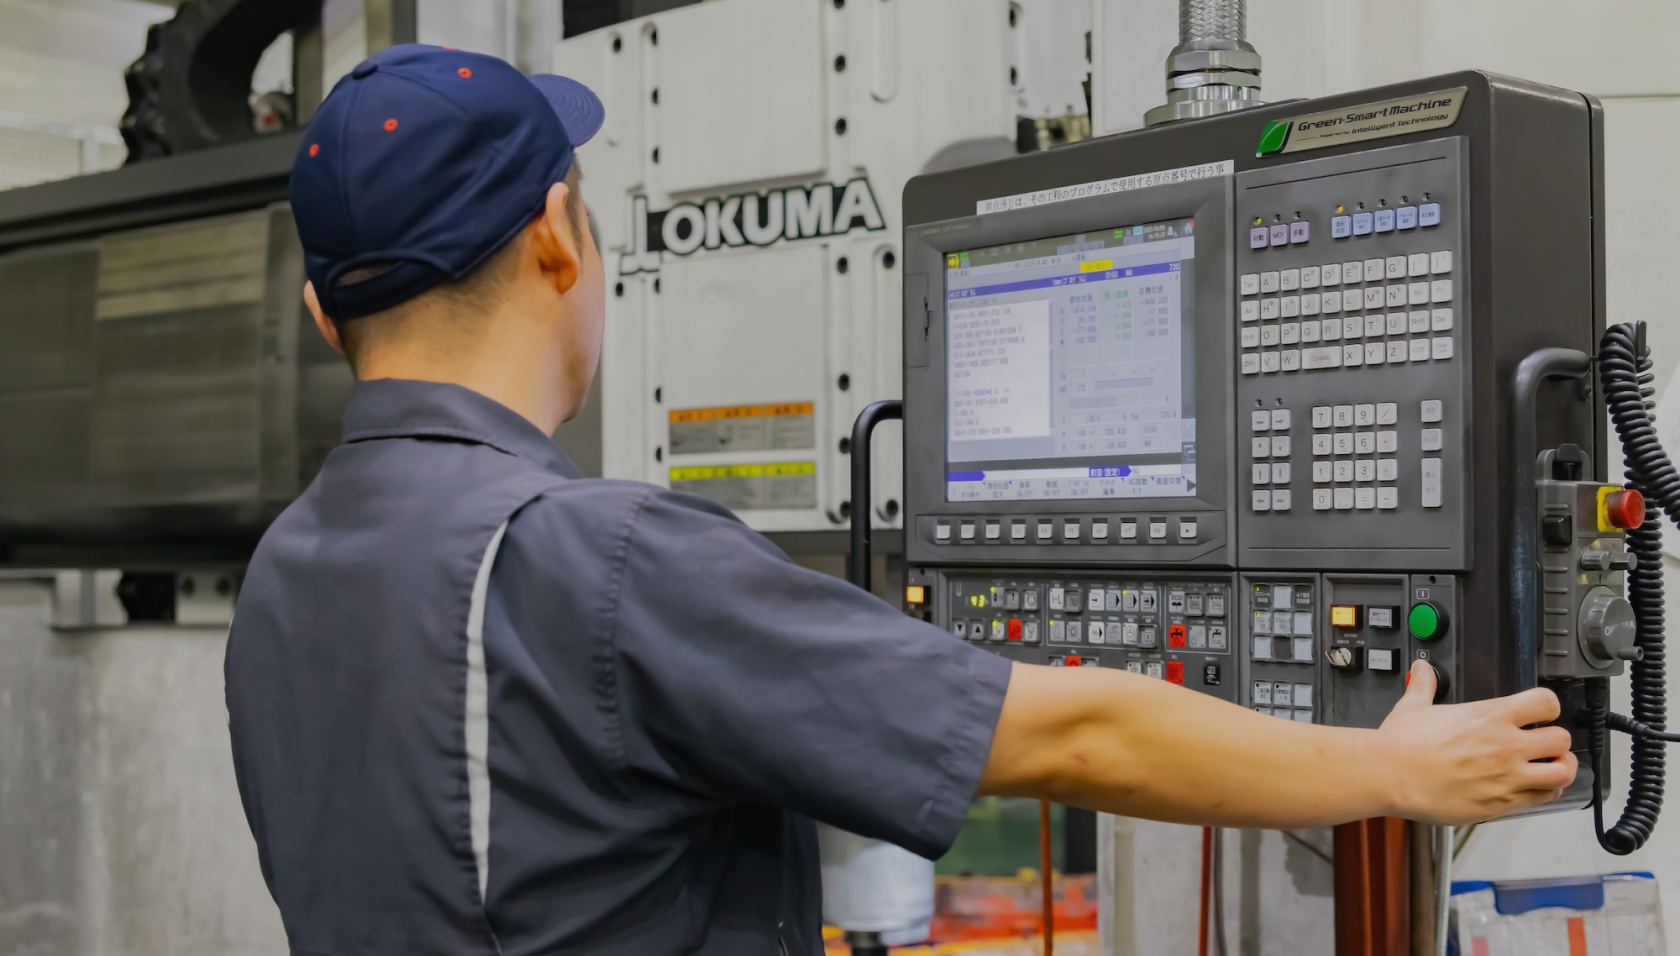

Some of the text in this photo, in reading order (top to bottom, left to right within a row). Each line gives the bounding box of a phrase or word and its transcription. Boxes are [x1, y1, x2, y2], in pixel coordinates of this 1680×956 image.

[1389, 98, 1452, 116] Machine
[1351, 121, 1396, 134] Intelligent
[1397, 113, 1449, 128] Technology
[660, 177, 886, 256] OKUMA
[1293, 229, 1304, 237] 手動
[1367, 265, 1373, 274] F
[1388, 264, 1396, 272] G
[1303, 273, 1310, 282] C
[1324, 271, 1331, 280] D
[1346, 269, 1352, 277] E
[1283, 276, 1290, 284] B
[1346, 296, 1352, 304] L
[1366, 294, 1374, 302] M
[1389, 291, 1396, 300] N
[1304, 300, 1310, 309] J
[1324, 298, 1331, 306] K
[1263, 305, 1269, 313] H
[1346, 323, 1353, 332] S
[1368, 321, 1374, 331] T
[1390, 319, 1397, 329] U
[1145, 328, 1168, 337] 100000
[1284, 329, 1290, 338] P
[1304, 327, 1311, 337] Q
[1324, 325, 1331, 334] R
[1346, 351, 1353, 360] X
[1367, 349, 1375, 358] Y
[1390, 347, 1397, 357] Z
[1263, 357, 1270, 366] V
[1282, 356, 1292, 364] W
[1318, 412, 1324, 422] 7
[1339, 411, 1345, 421] 8
[1360, 410, 1367, 420] 9
[1318, 440, 1324, 448] 4
[1339, 438, 1345, 448] 5
[1360, 438, 1367, 447] 6
[1318, 468, 1323, 476] 1
[1339, 467, 1346, 476] 2
[1361, 466, 1367, 475] 3
[1318, 495, 1325, 504] 0
